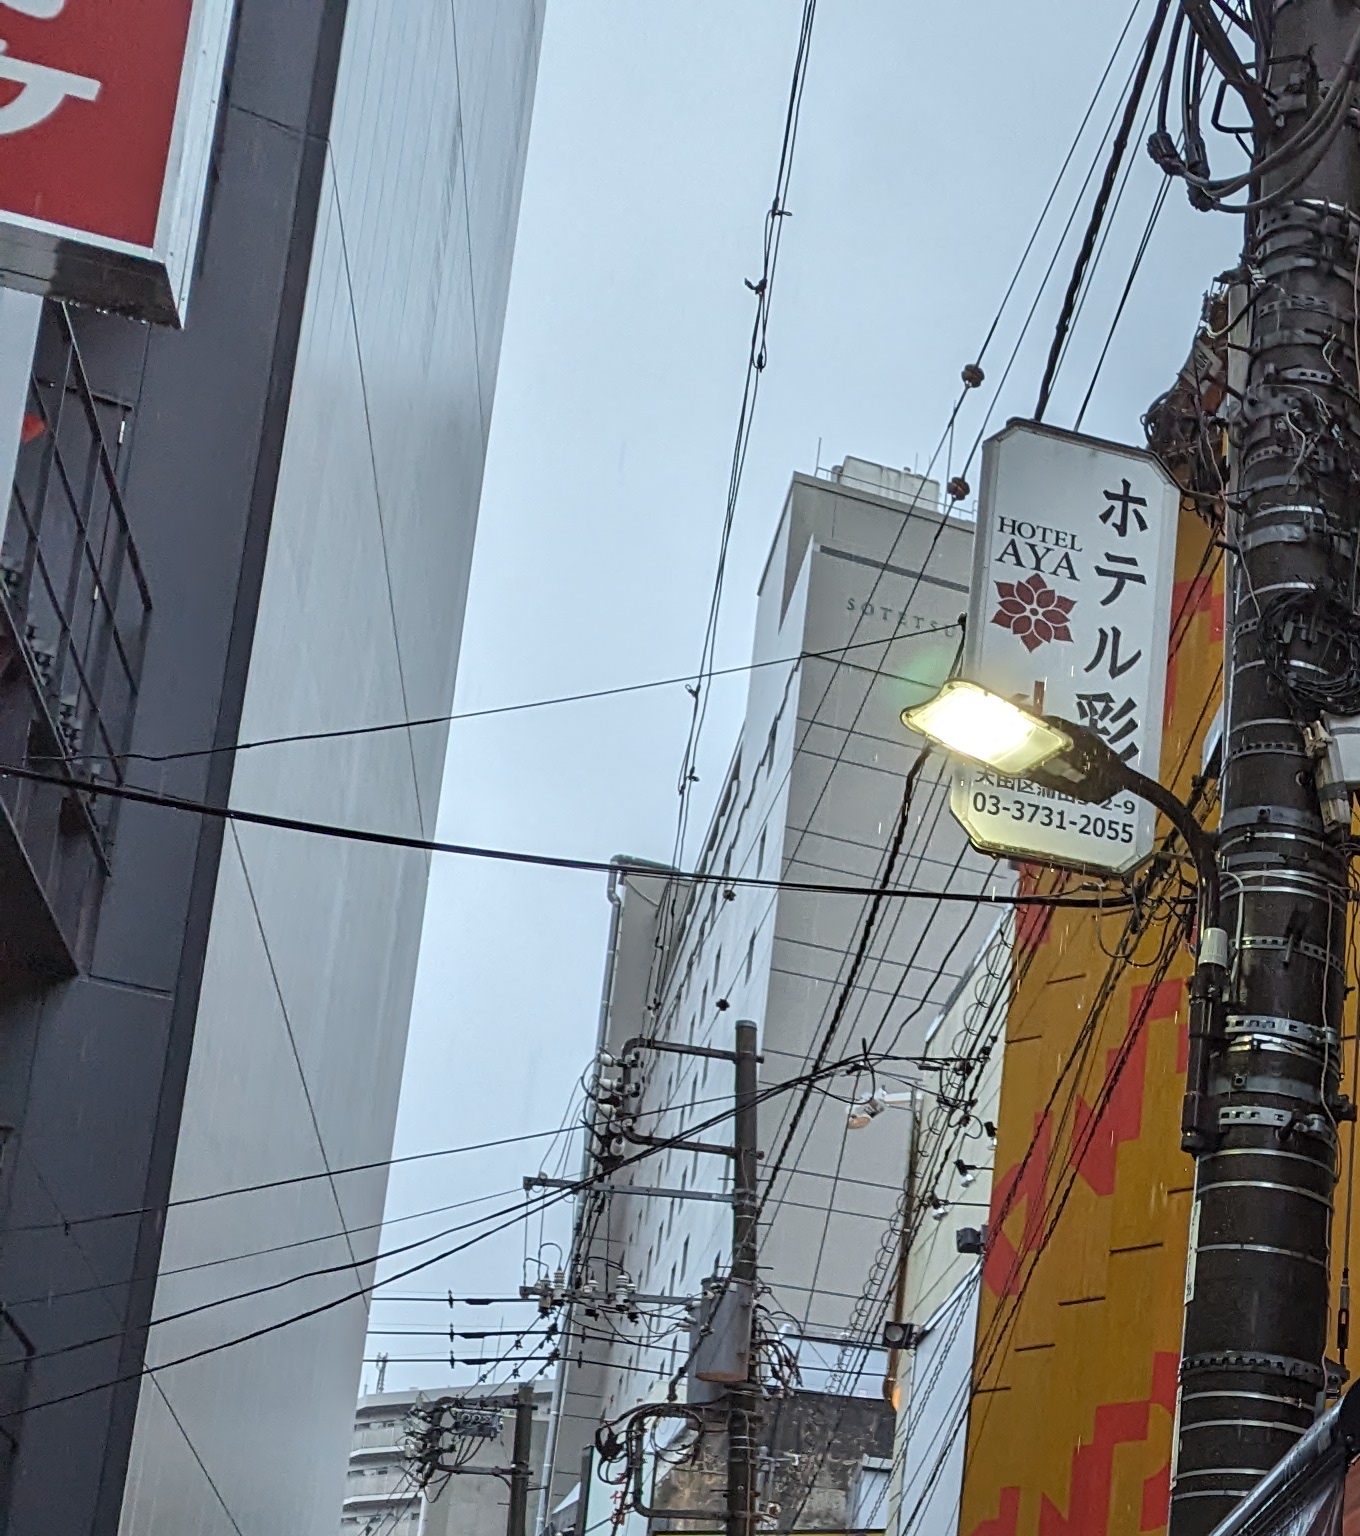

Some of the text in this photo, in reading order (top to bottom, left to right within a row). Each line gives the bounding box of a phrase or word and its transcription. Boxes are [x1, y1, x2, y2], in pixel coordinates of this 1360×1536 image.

[997, 516, 1083, 553] HOTEL
[995, 538, 1081, 582] AYA
[972, 791, 1134, 844] 03-3731-2055
